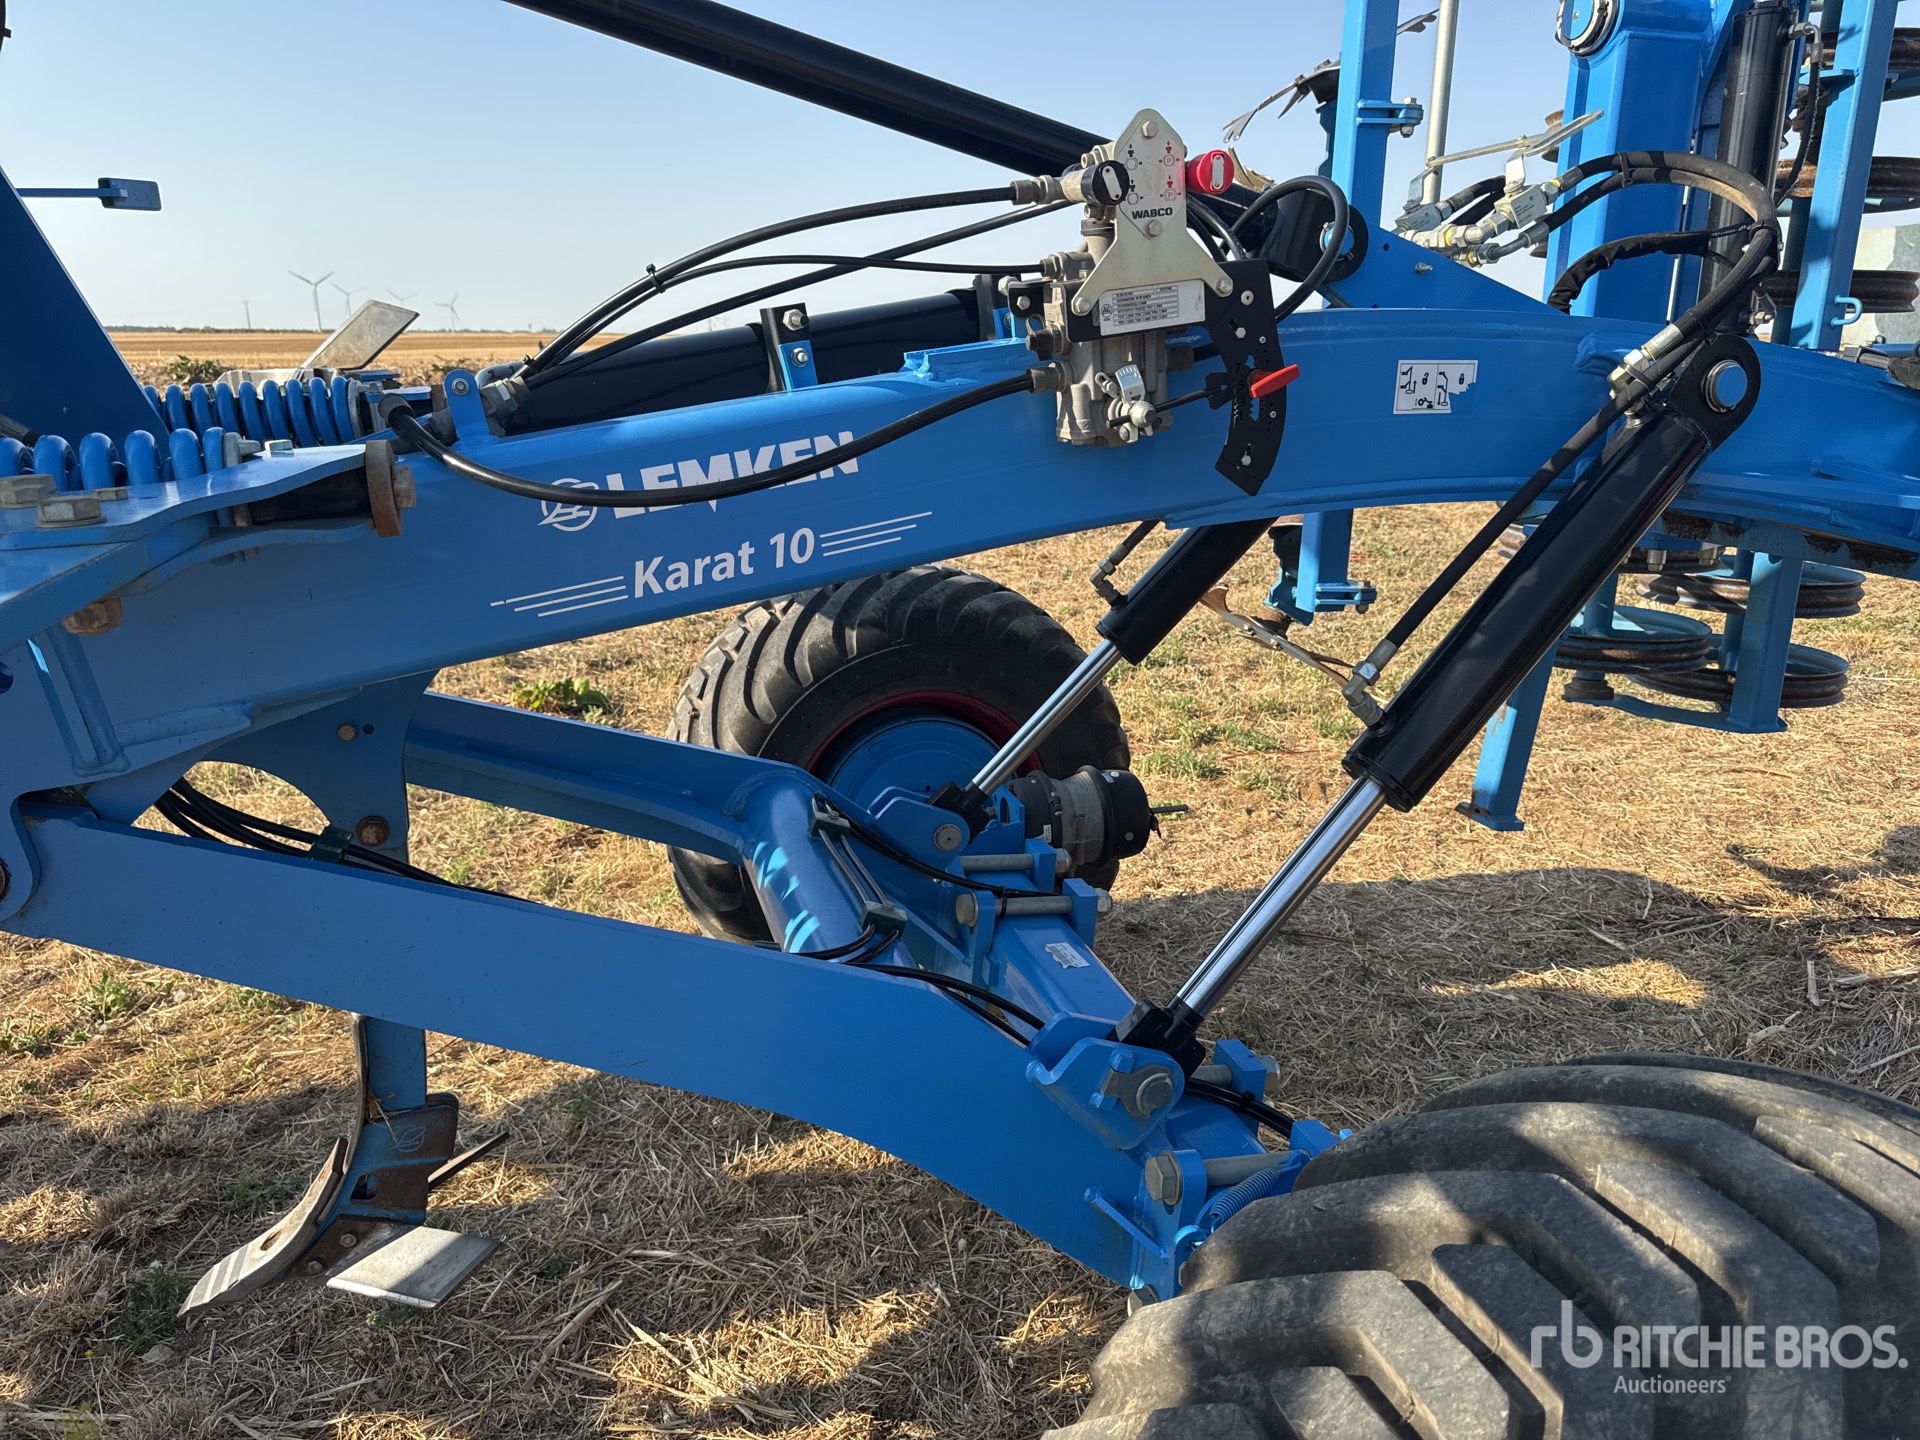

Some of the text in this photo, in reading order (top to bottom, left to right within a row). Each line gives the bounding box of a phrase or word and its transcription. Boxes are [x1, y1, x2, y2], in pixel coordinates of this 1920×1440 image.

[1132, 207, 1173, 219] WABCO
[634, 527, 814, 598] Karat 10
